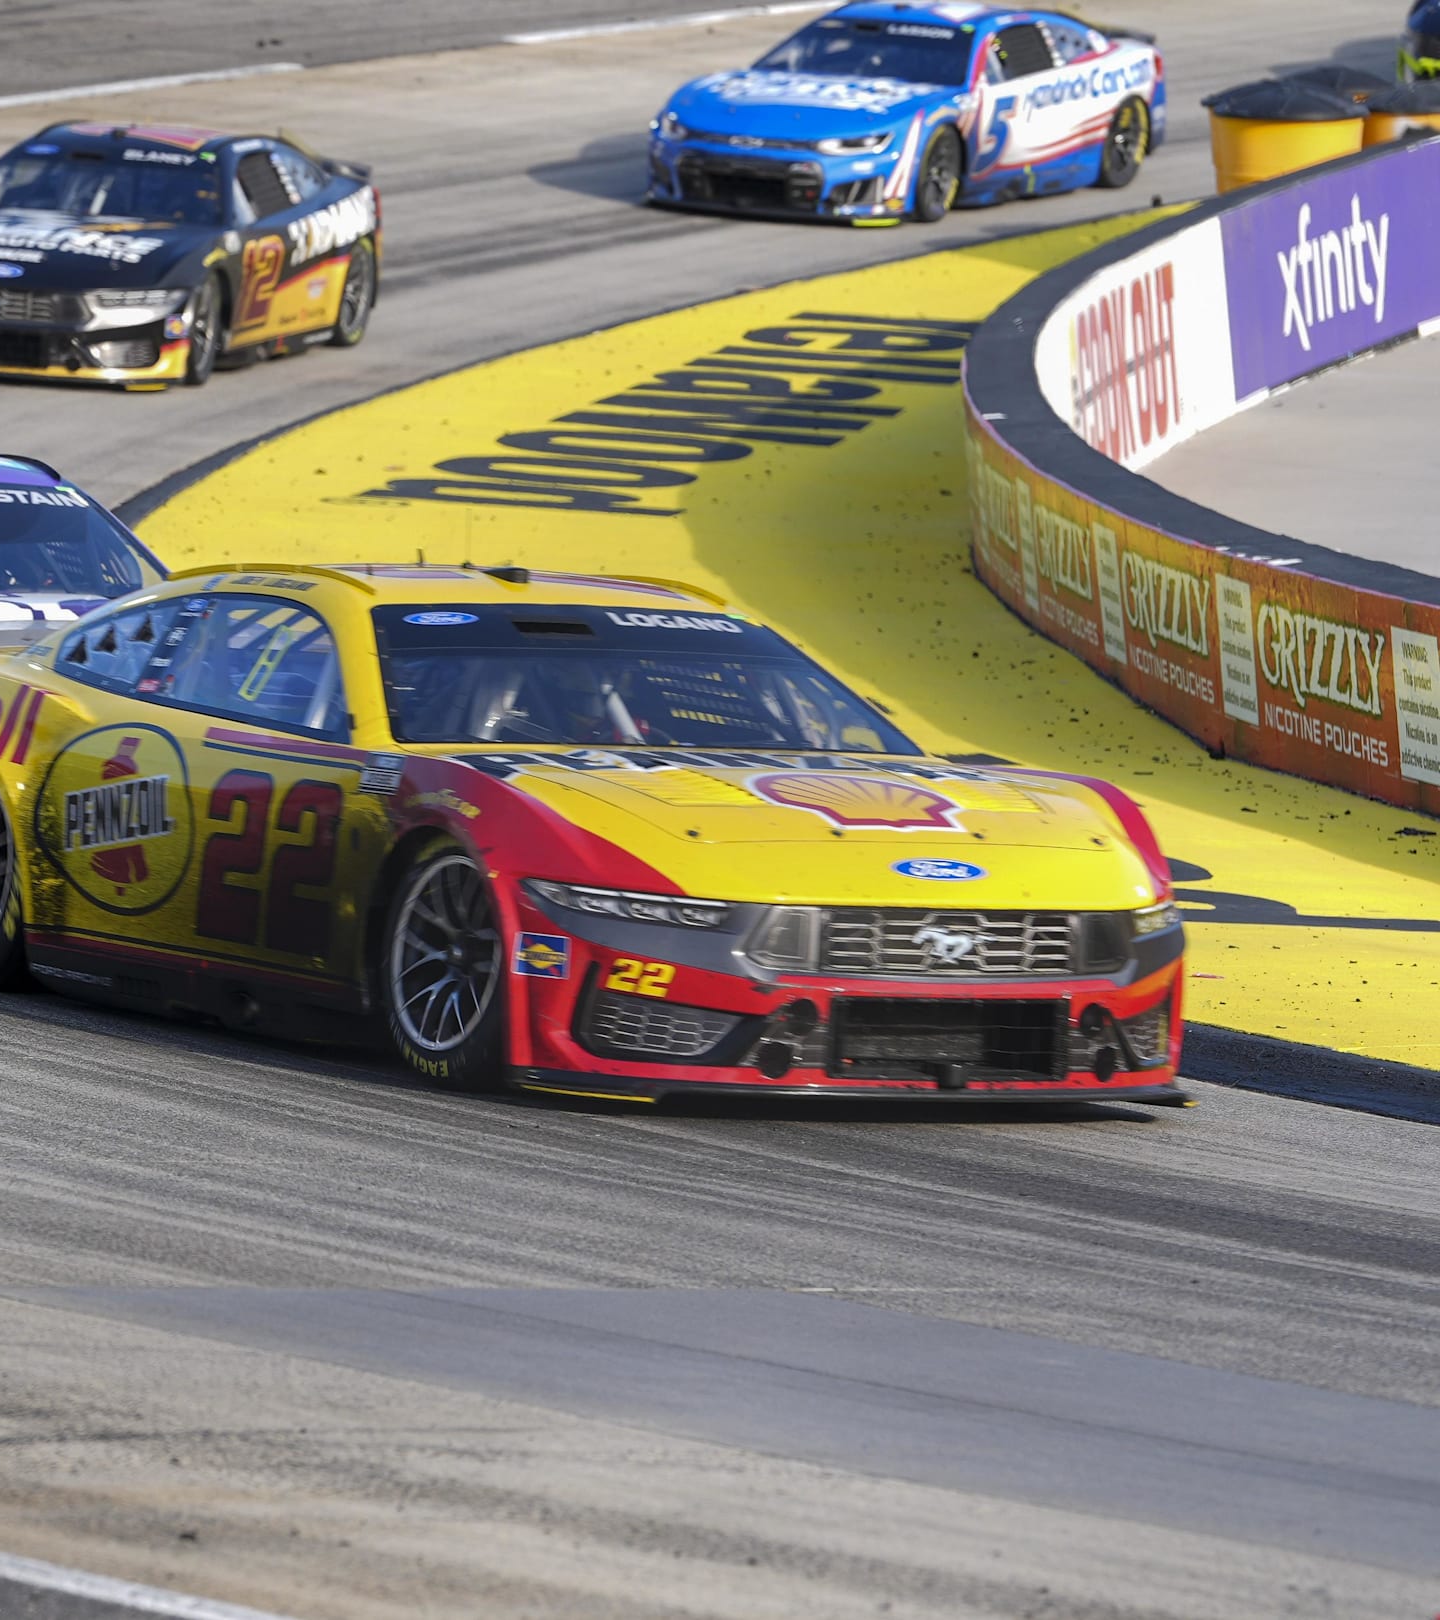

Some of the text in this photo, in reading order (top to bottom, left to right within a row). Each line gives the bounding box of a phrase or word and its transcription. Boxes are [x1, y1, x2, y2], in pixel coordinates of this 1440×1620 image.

[887, 23, 955, 40] LARSON
[123, 148, 197, 165] BLANEY
[970, 94, 1019, 180] 5
[232, 233, 286, 327] 12
[1277, 193, 1389, 351] xfinity
[1131, 261, 1180, 448] OUT
[1033, 502, 1093, 601] GRIZZLY
[604, 611, 743, 634] LOGANO
[1121, 550, 1211, 658] GRIZZLY
[1129, 643, 1215, 705] NICOTINE POUCHES
[1256, 602, 1386, 716] GRIZZLY
[1263, 701, 1389, 768] NICOTINE POUCHES
[62, 774, 177, 851] PENNZOIL
[194, 767, 345, 957] 22
[907, 860, 972, 878] Ford
[605, 957, 677, 999] 22
